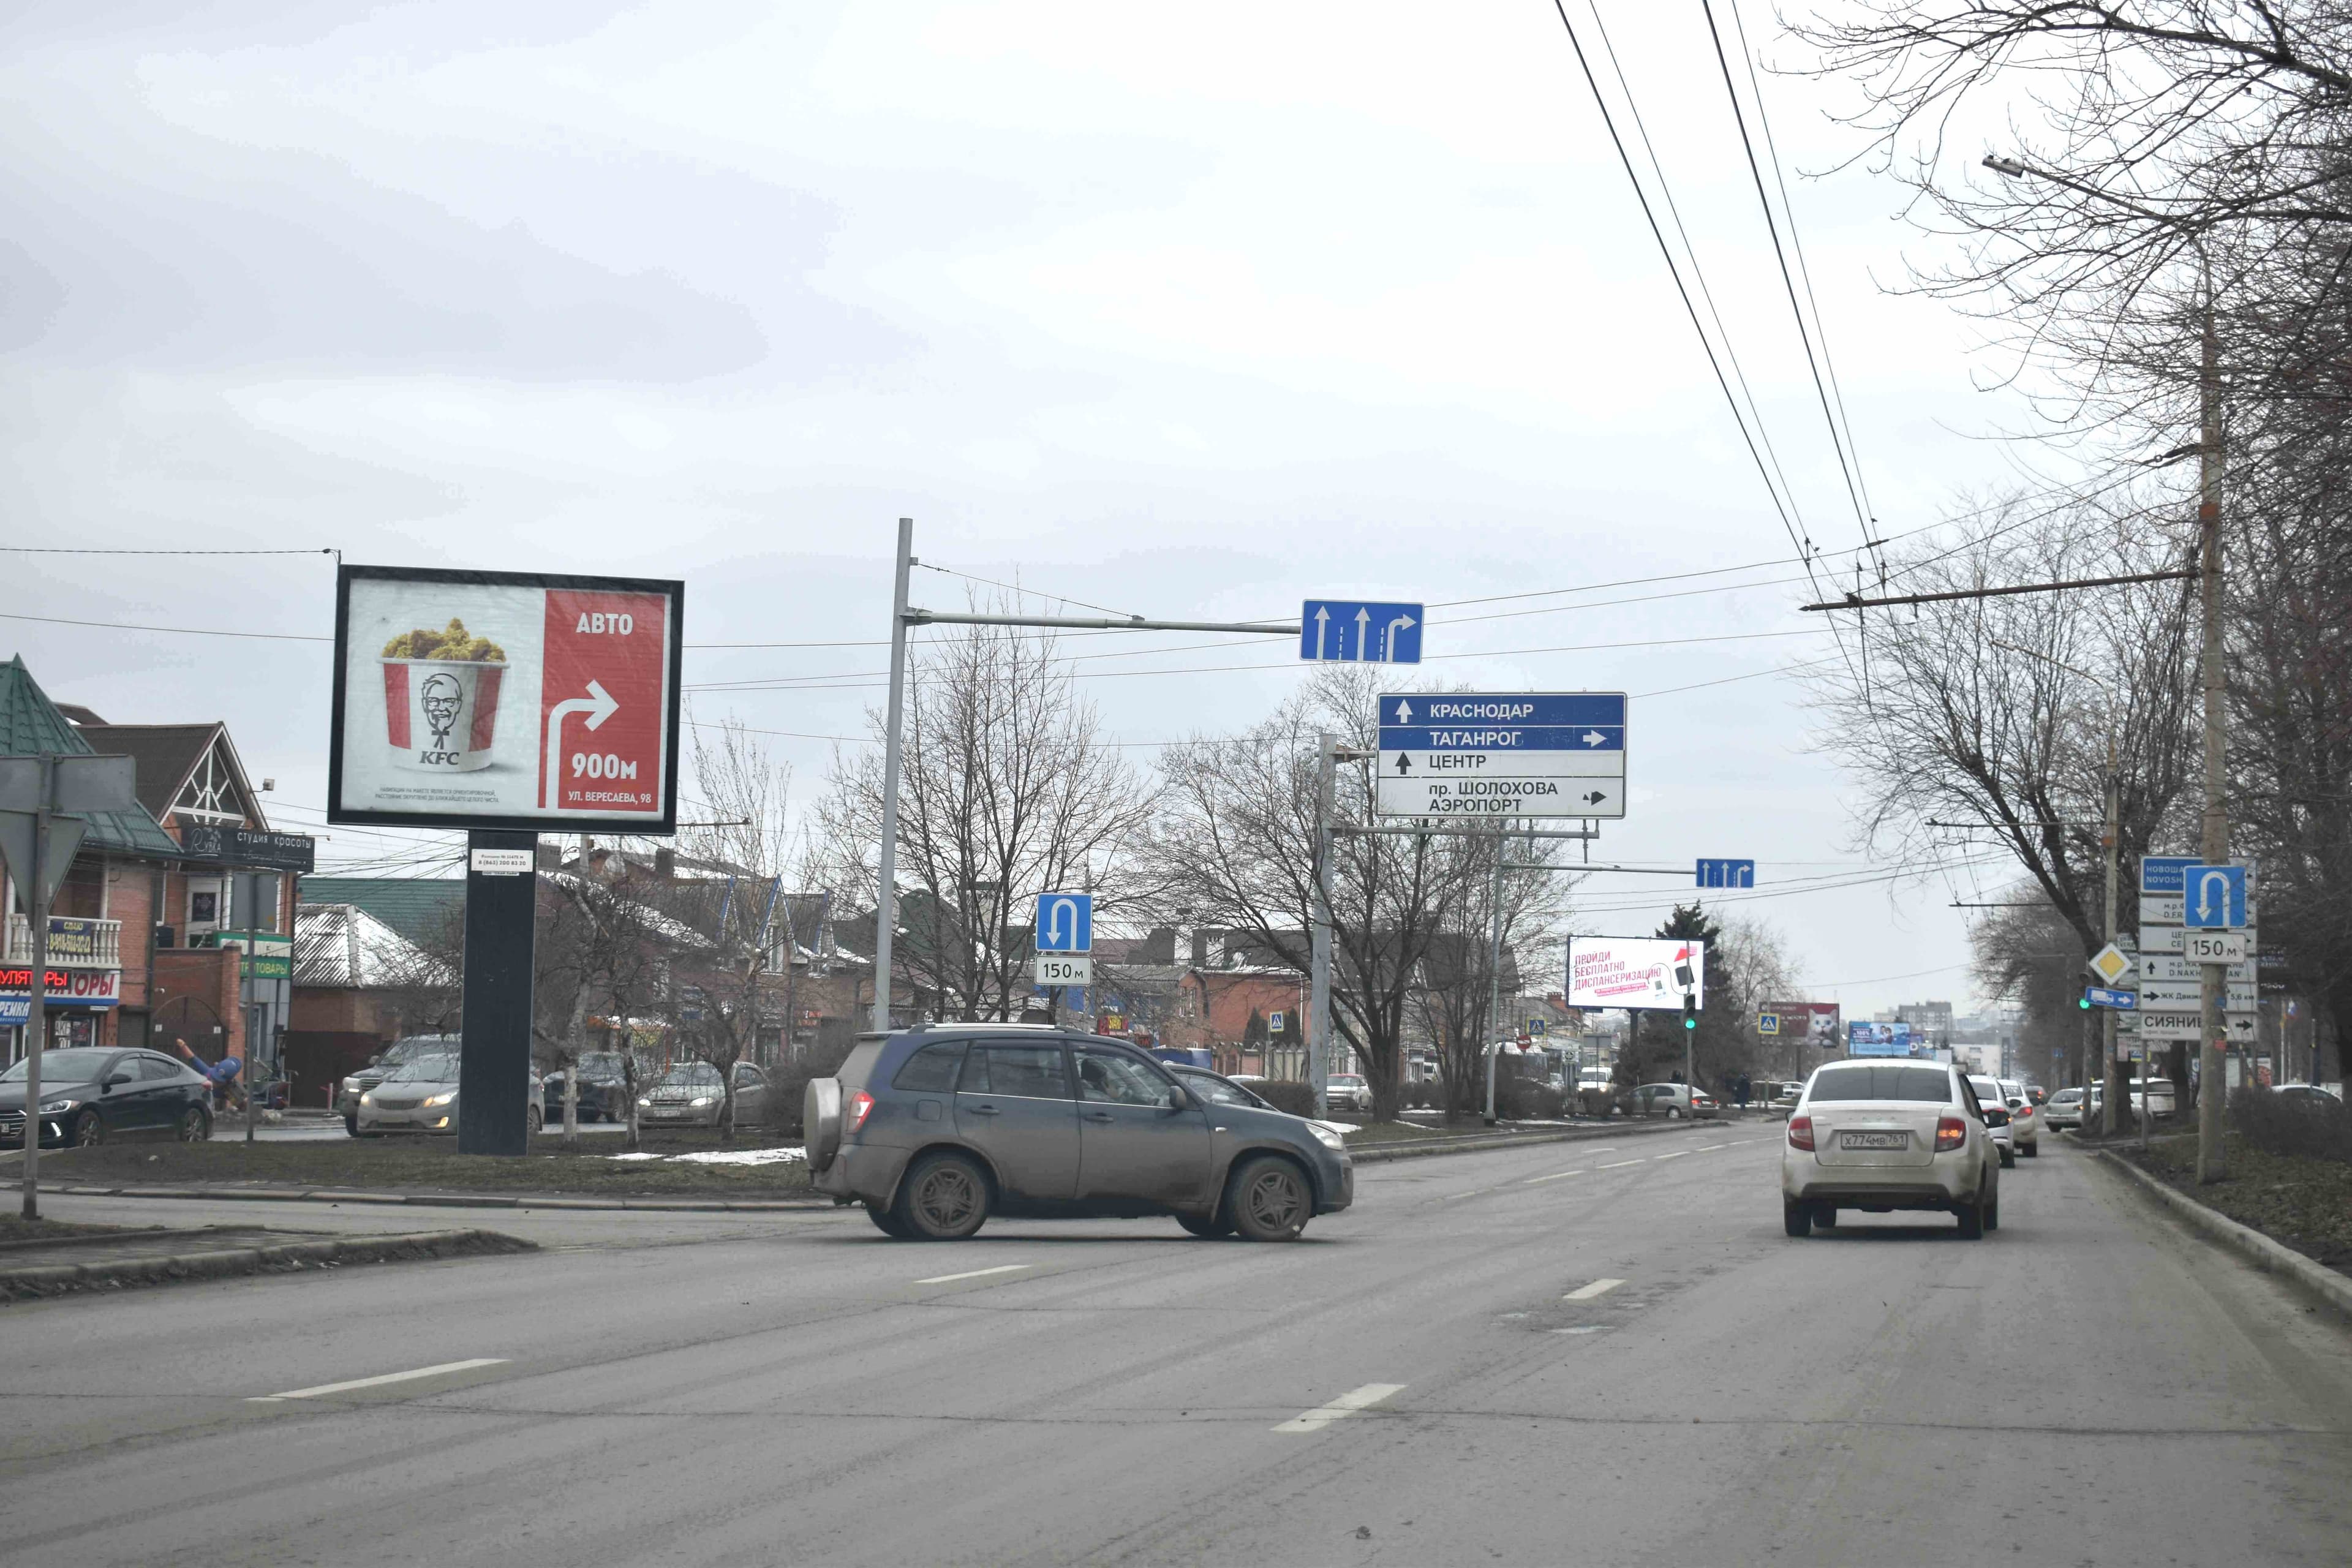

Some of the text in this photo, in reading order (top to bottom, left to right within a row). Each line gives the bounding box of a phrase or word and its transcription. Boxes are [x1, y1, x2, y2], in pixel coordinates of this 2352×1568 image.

[576, 612, 633, 635] АВТО
[1430, 704, 1534, 720] КРАСНОДАР
[1430, 732, 1521, 746] ТАГАНРОГ
[420, 751, 459, 766] KFC
[1429, 755, 1487, 770] ЦЕНТР
[1429, 782, 1558, 796] пр. ШОЛОХОВА
[568, 791, 583, 801] УЛ.
[641, 794, 651, 804] 98
[1429, 799, 1521, 812] АЭРОПОРТ
[274, 837, 311, 849] красоты
[2192, 940, 2223, 956] 150
[1575, 951, 1611, 966] ПРОЙДИ
[1044, 963, 1071, 978] 150
[1575, 961, 1625, 978] БЕСПЛАТНО
[1574, 968, 1661, 991] ДИСПАНСЕРИЗАЦИЮ
